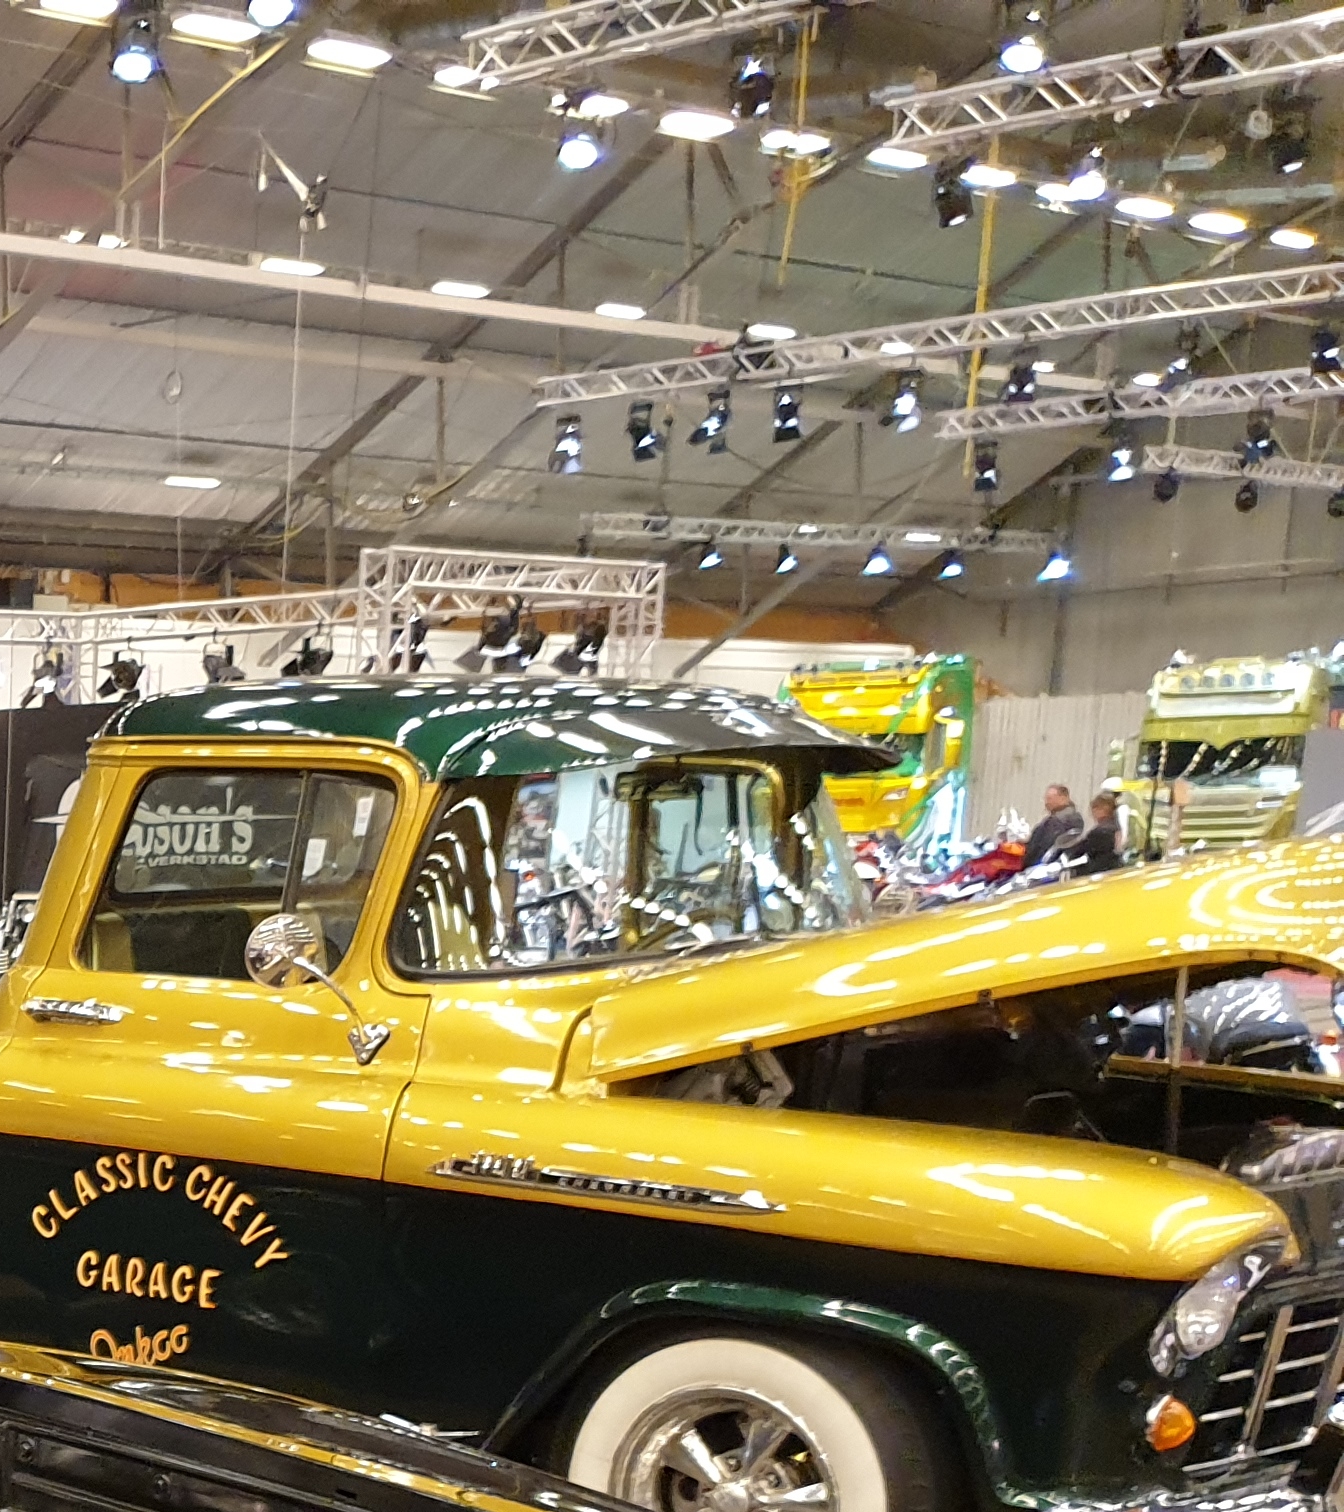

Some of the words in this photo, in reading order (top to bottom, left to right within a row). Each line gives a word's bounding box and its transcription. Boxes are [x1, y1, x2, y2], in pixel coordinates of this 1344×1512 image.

[32, 1151, 176, 1238] CLASSIC
[185, 1165, 291, 1268] CHEVY
[76, 1250, 223, 1309] GARAGE
